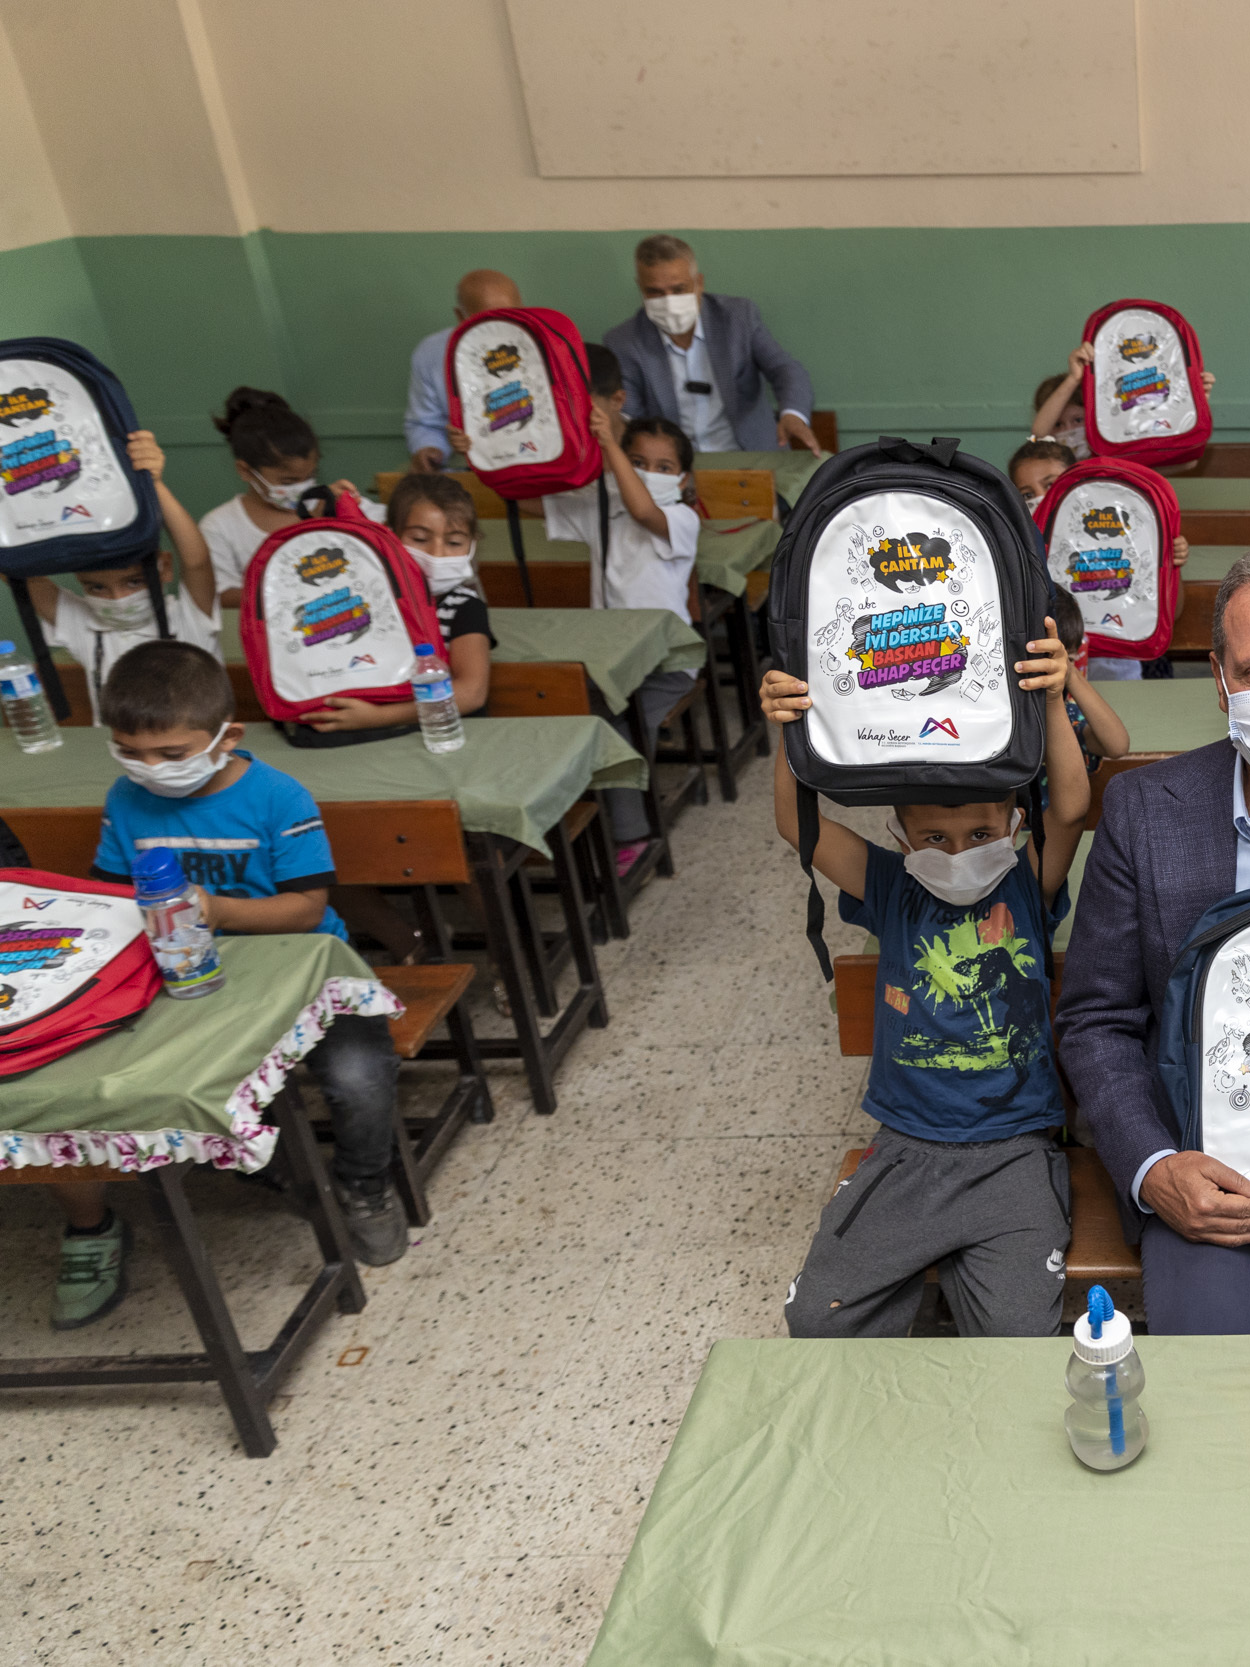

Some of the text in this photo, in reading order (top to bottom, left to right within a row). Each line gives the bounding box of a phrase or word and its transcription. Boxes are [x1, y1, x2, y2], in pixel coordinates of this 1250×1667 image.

[897, 542, 922, 559] İLK
[880, 556, 944, 576] ÇANTAM
[871, 604, 945, 631] HEPİNİZE
[865, 621, 961, 650] İYİ DERSLER
[858, 653, 962, 687] VAHAP SEÇER
[857, 728, 886, 746] Vahap
